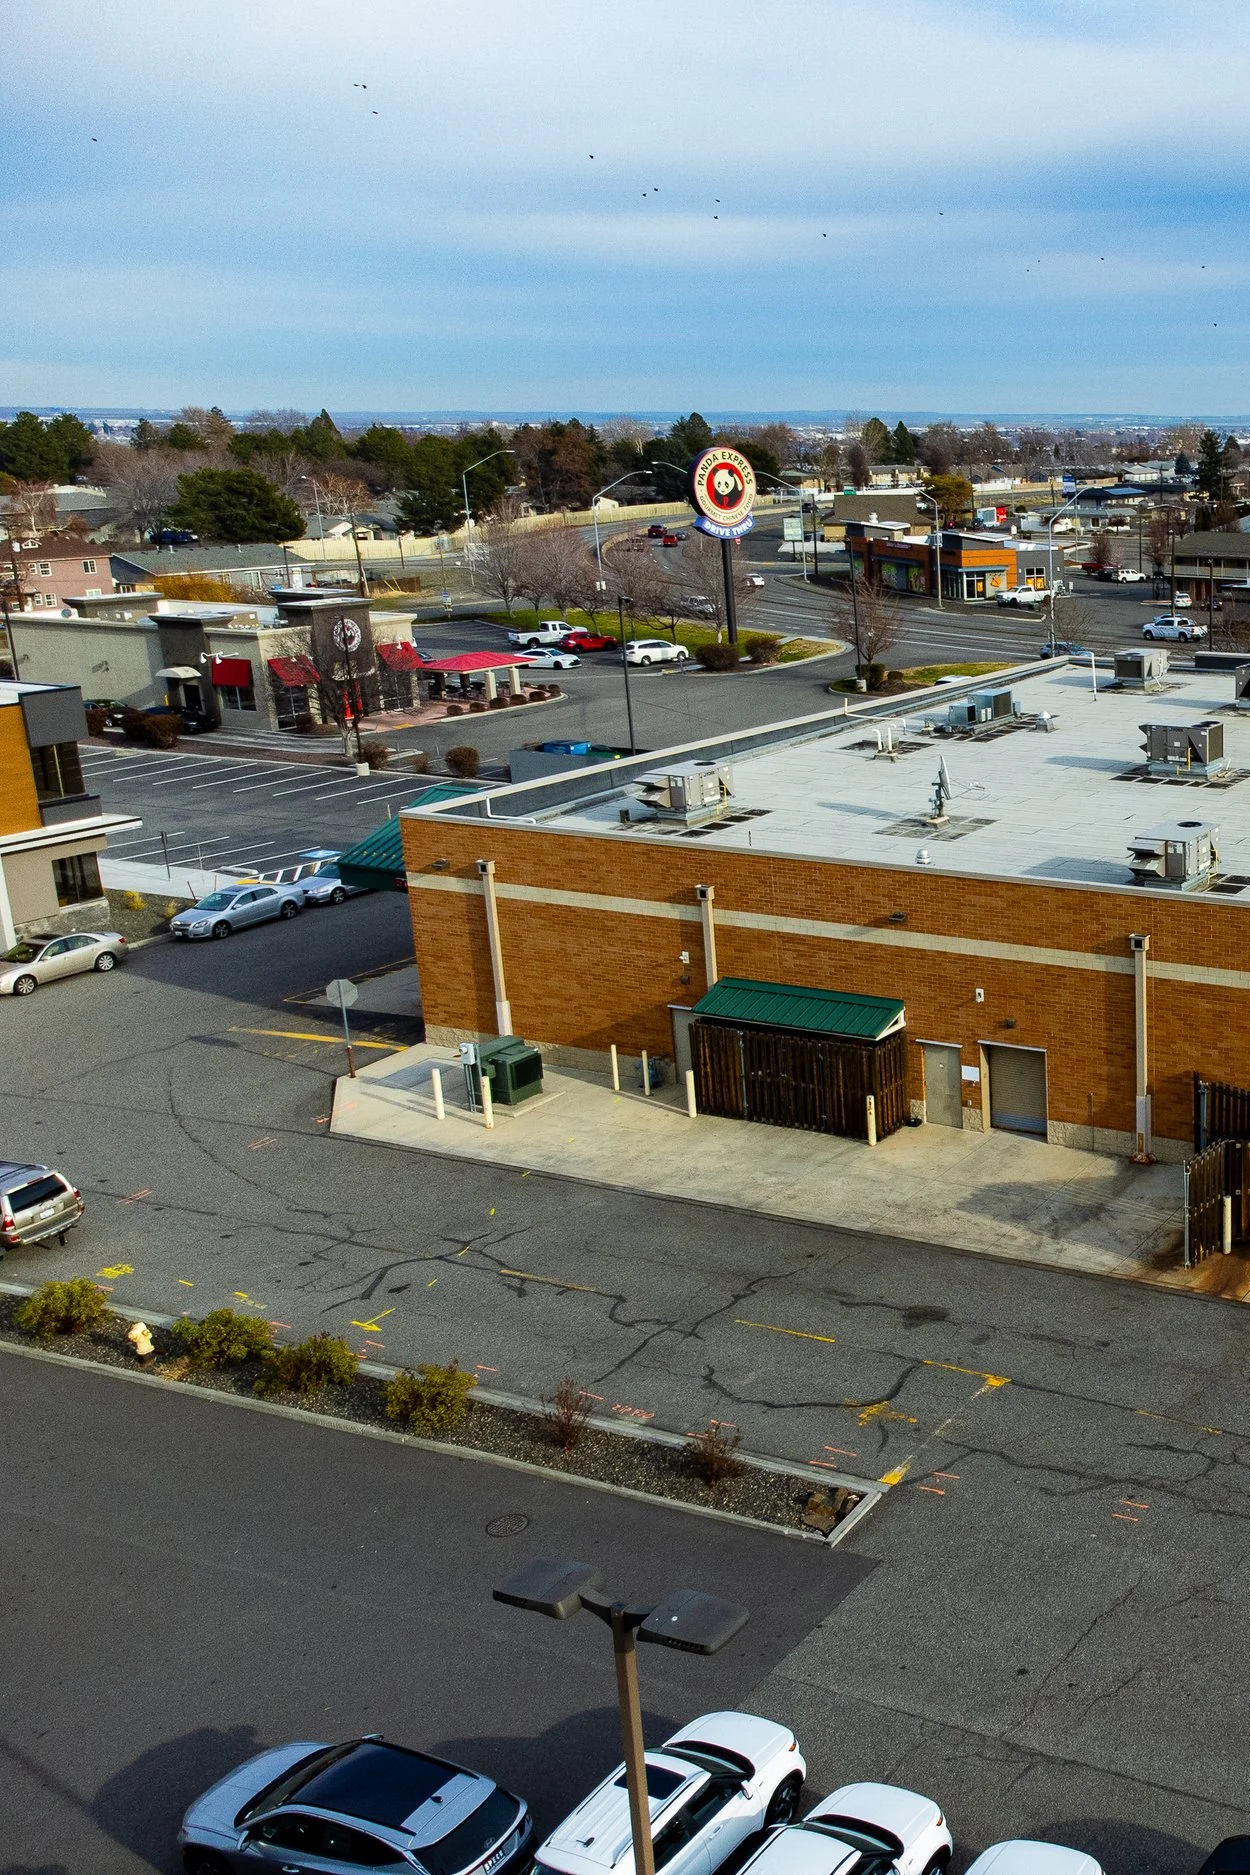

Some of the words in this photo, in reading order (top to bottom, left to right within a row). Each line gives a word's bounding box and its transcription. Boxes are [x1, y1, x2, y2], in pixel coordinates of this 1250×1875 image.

[697, 453, 719, 486] PANDA
[721, 451, 753, 485] EXPRESS
[722, 510, 744, 521] CHINESE
[743, 493, 753, 510] FOOD
[703, 520, 731, 536] DRIVE
[732, 519, 753, 535] THRU
[484, 1850, 504, 1870] SPECK
